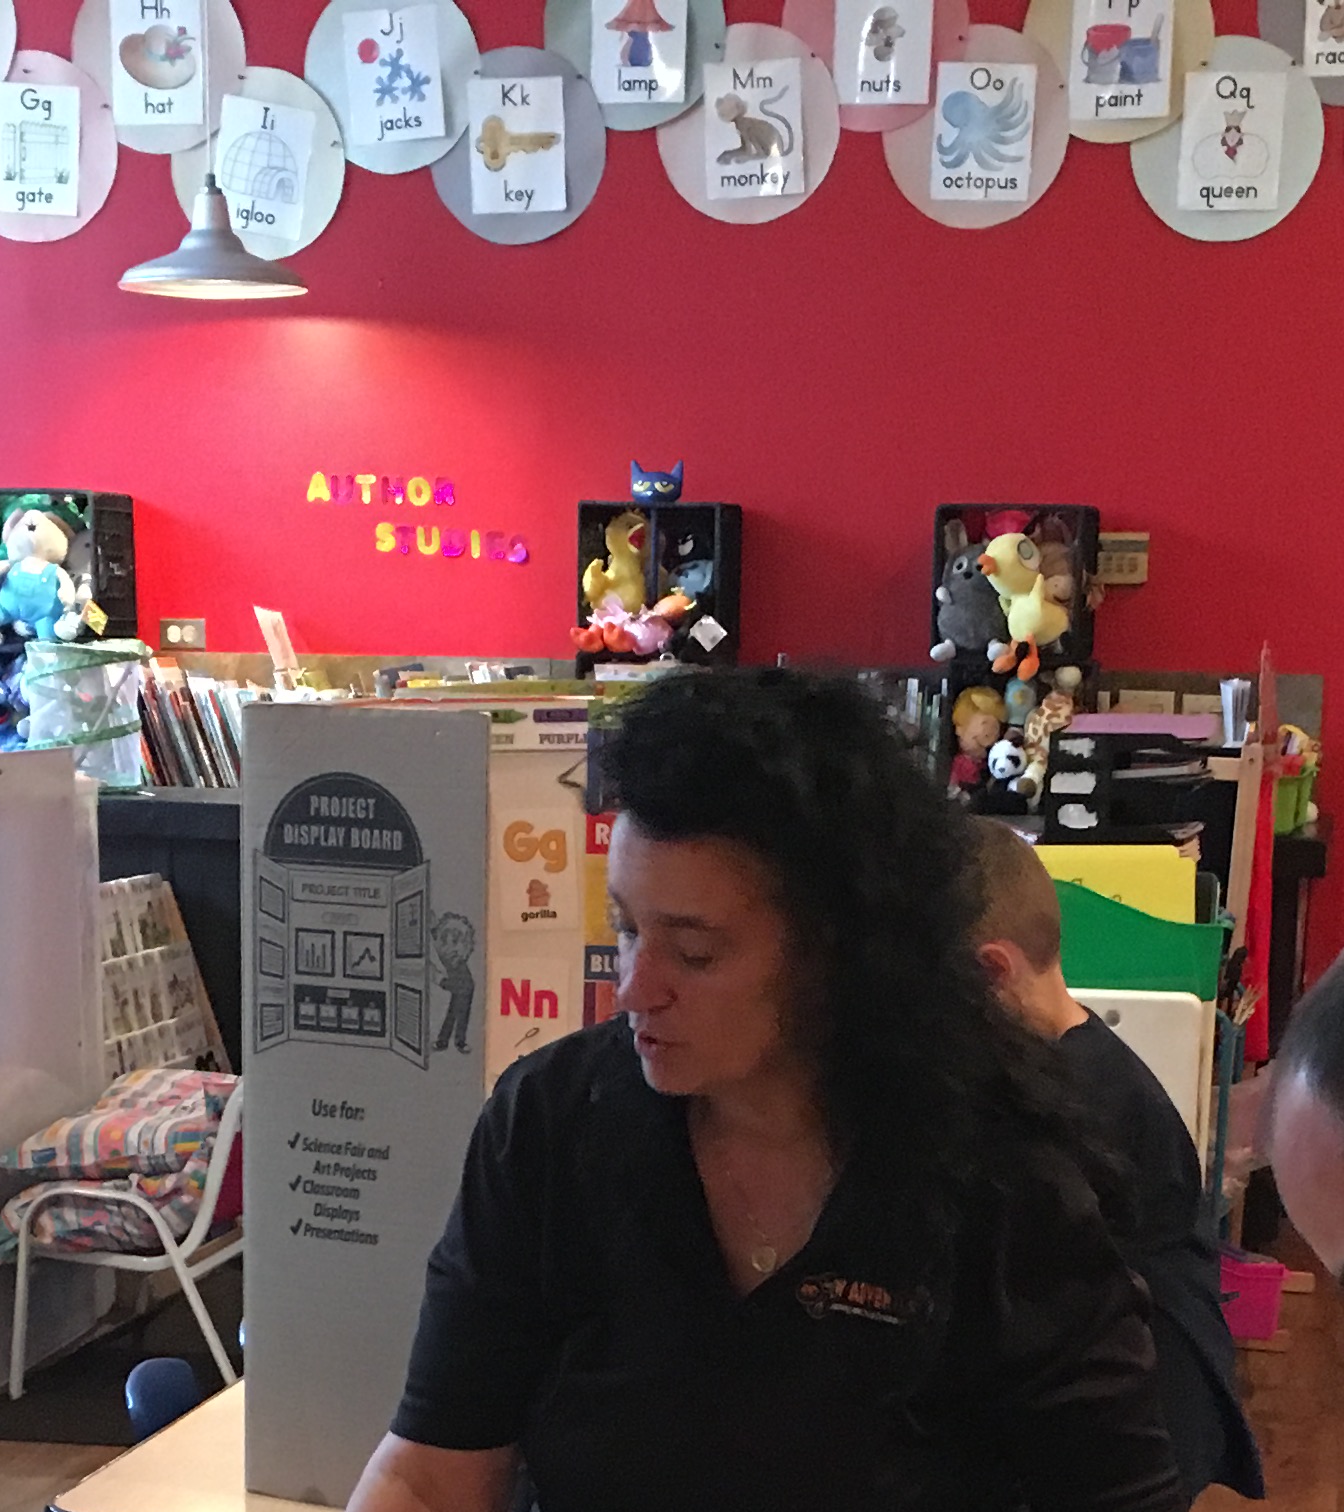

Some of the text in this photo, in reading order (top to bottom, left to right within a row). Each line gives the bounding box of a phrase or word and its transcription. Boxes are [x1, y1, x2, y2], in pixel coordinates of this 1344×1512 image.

[141, 0, 169, 19] Hh
[379, 12, 406, 44] Jj
[617, 66, 659, 98] lamp
[732, 71, 773, 91] Mm
[860, 75, 902, 95] nuts
[969, 66, 1004, 92] Oo
[19, 88, 53, 119] Gg
[144, 94, 174, 115] hat
[500, 83, 531, 108] Kk
[1094, 89, 1144, 116] paint
[1214, 76, 1251, 108] Qq
[377, 111, 424, 141] jacks
[720, 167, 790, 198] monkey
[942, 172, 1019, 199] octopus
[15, 187, 54, 208] gate
[504, 185, 535, 211] key
[1199, 183, 1259, 208] queen
[236, 202, 276, 227] igloo
[307, 472, 455, 506] AUTHOR
[375, 522, 529, 563] STUDIES
[539, 733, 587, 745] PURPL
[310, 795, 376, 819] PROJECT
[283, 823, 403, 851] DISPLAY BOARD
[503, 821, 568, 873] Gg
[301, 883, 381, 899] PROJECT TITLE
[521, 909, 557, 922] gorilla
[500, 978, 558, 1018] Nn
[312, 1099, 365, 1120] Use for:
[302, 1137, 390, 1160] Science Fair and
[313, 1160, 378, 1182] Art Projects
[303, 1180, 361, 1200] Classroom
[314, 1203, 361, 1224] Displays
[304, 1224, 379, 1246] Presentations
